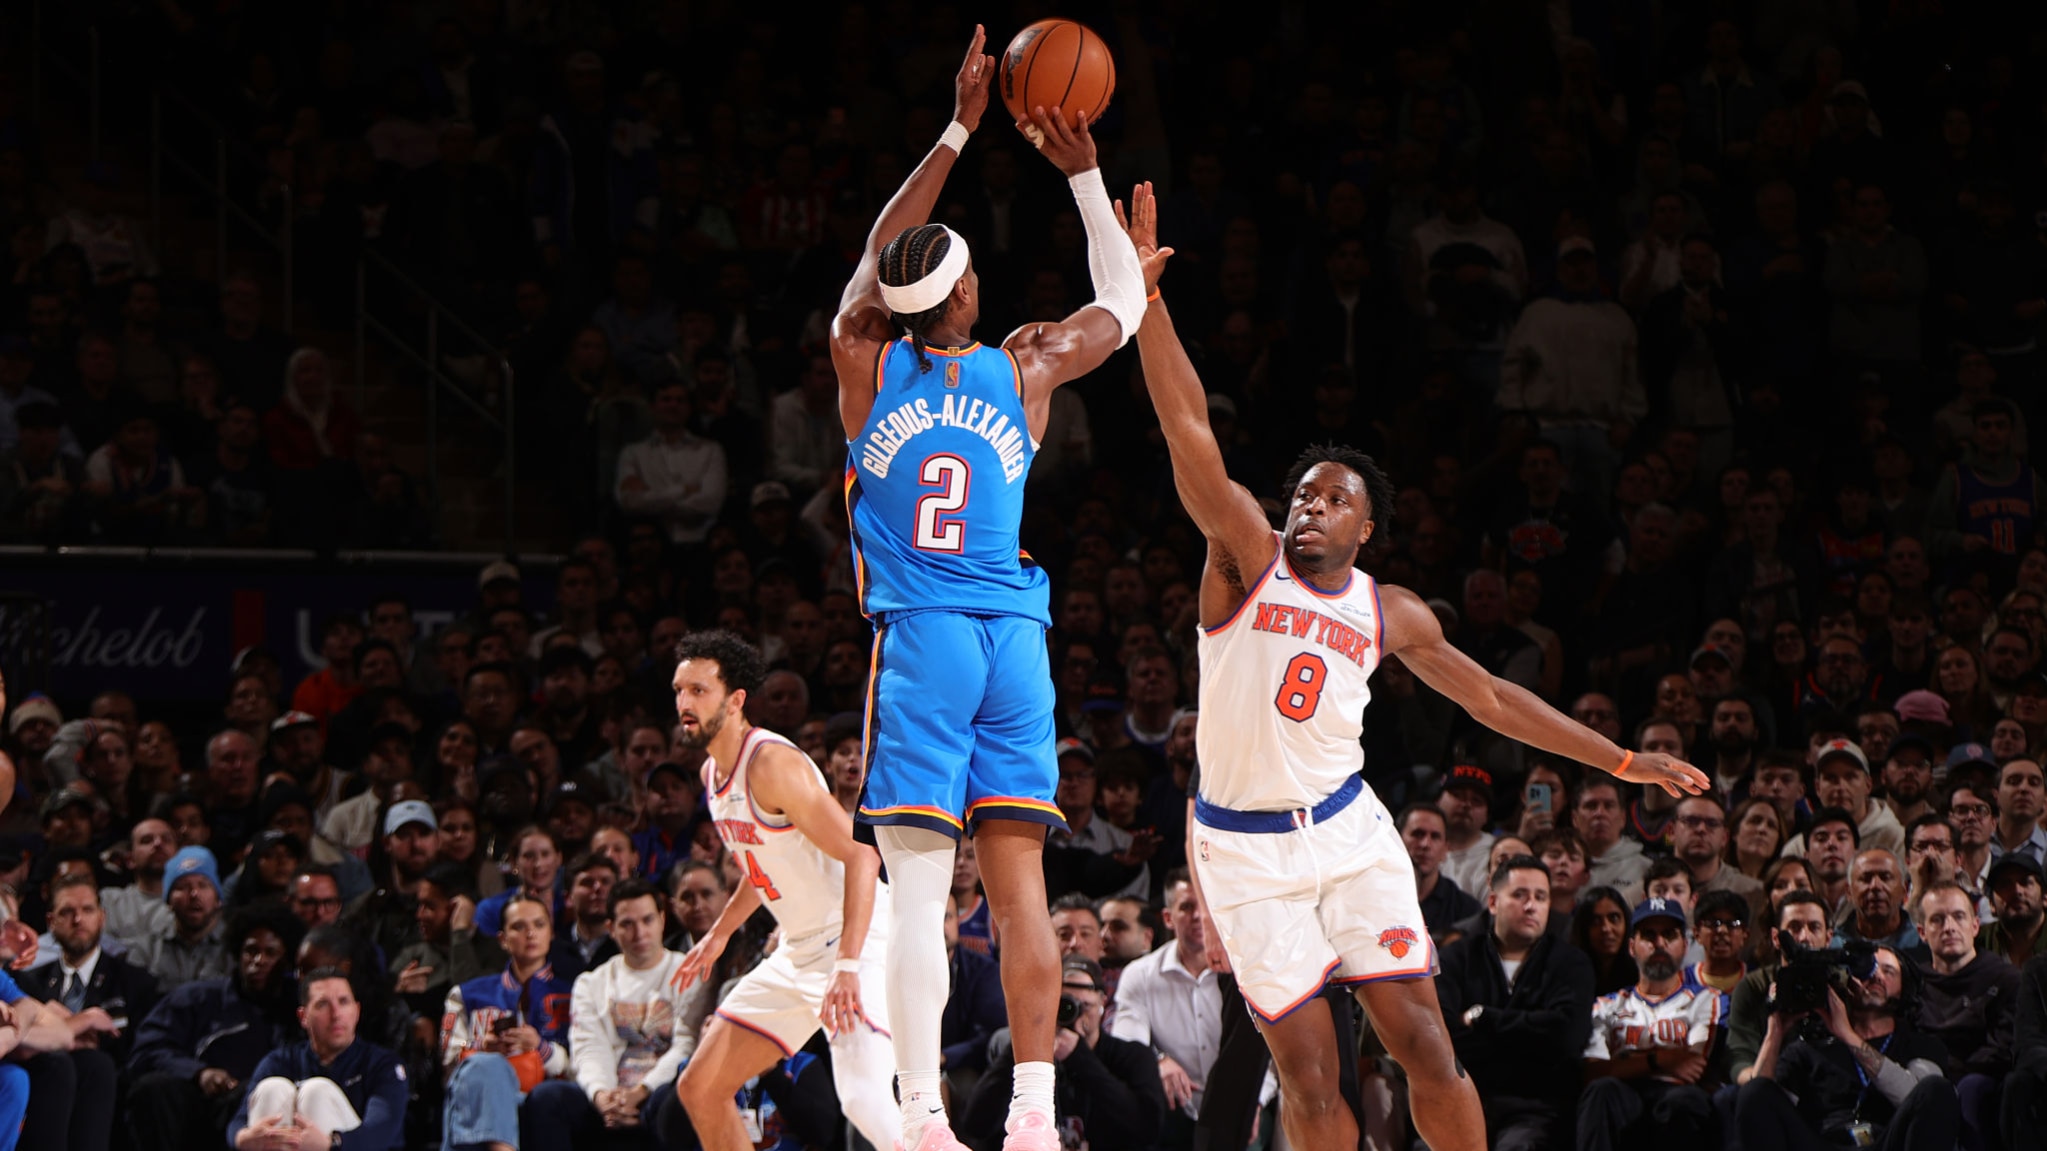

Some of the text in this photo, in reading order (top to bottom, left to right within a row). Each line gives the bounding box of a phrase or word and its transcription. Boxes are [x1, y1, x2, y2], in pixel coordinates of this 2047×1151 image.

[862, 393, 1025, 486] GILGEOUS-ALEXANDER
[912, 452, 972, 556] 2
[1991, 518, 2016, 555] 11
[1253, 602, 1372, 668] NEW YORK
[1274, 651, 1328, 723] 8
[733, 849, 782, 902] 4
